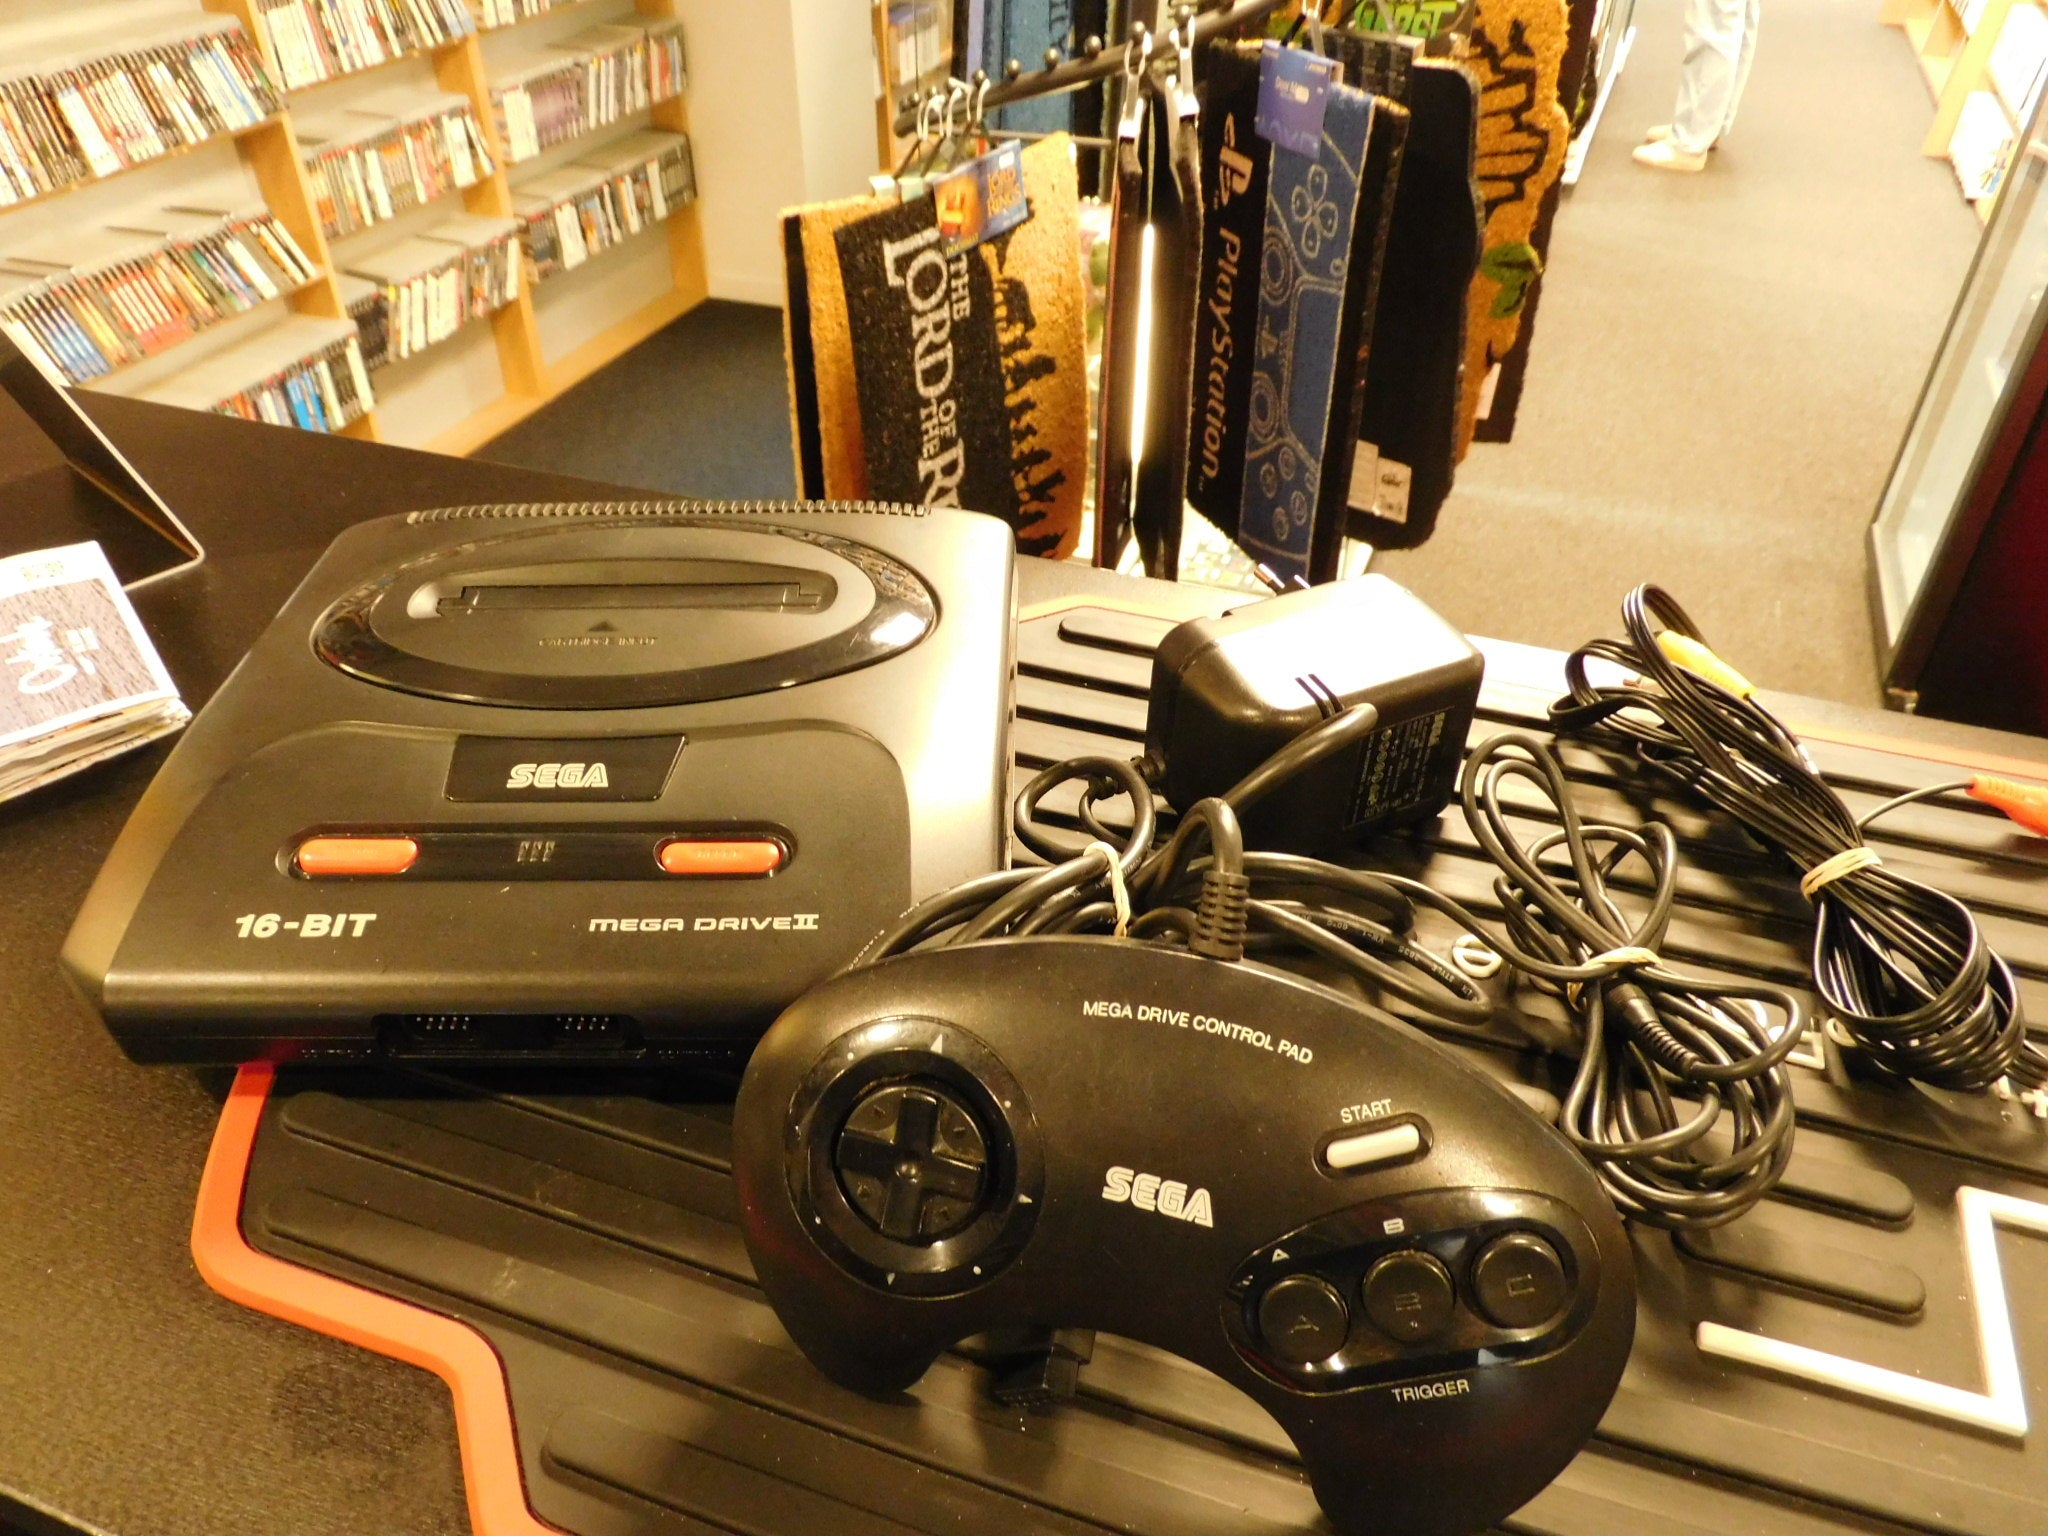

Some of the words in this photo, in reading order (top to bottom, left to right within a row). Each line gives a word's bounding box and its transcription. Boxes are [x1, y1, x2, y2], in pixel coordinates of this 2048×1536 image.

[949, 252, 971, 322] THE
[882, 226, 954, 399] LORD
[1202, 226, 1241, 479] PlayStation
[920, 397, 940, 459] THE
[939, 399, 957, 439] OF
[506, 762, 609, 789] SEGA
[235, 913, 378, 938] 16-BIT
[589, 918, 684, 932] MEGA
[1083, 1001, 1133, 1019] MEGA
[1137, 1005, 1190, 1028] DRIVE
[1193, 1015, 1274, 1051] CONTROL
[1278, 1039, 1313, 1064] PAD
[1340, 1098, 1393, 1124] START
[1102, 1165, 1213, 1228] SEGA
[1383, 1217, 1405, 1235] B
[1391, 1379, 1470, 1402] TRIGGER
